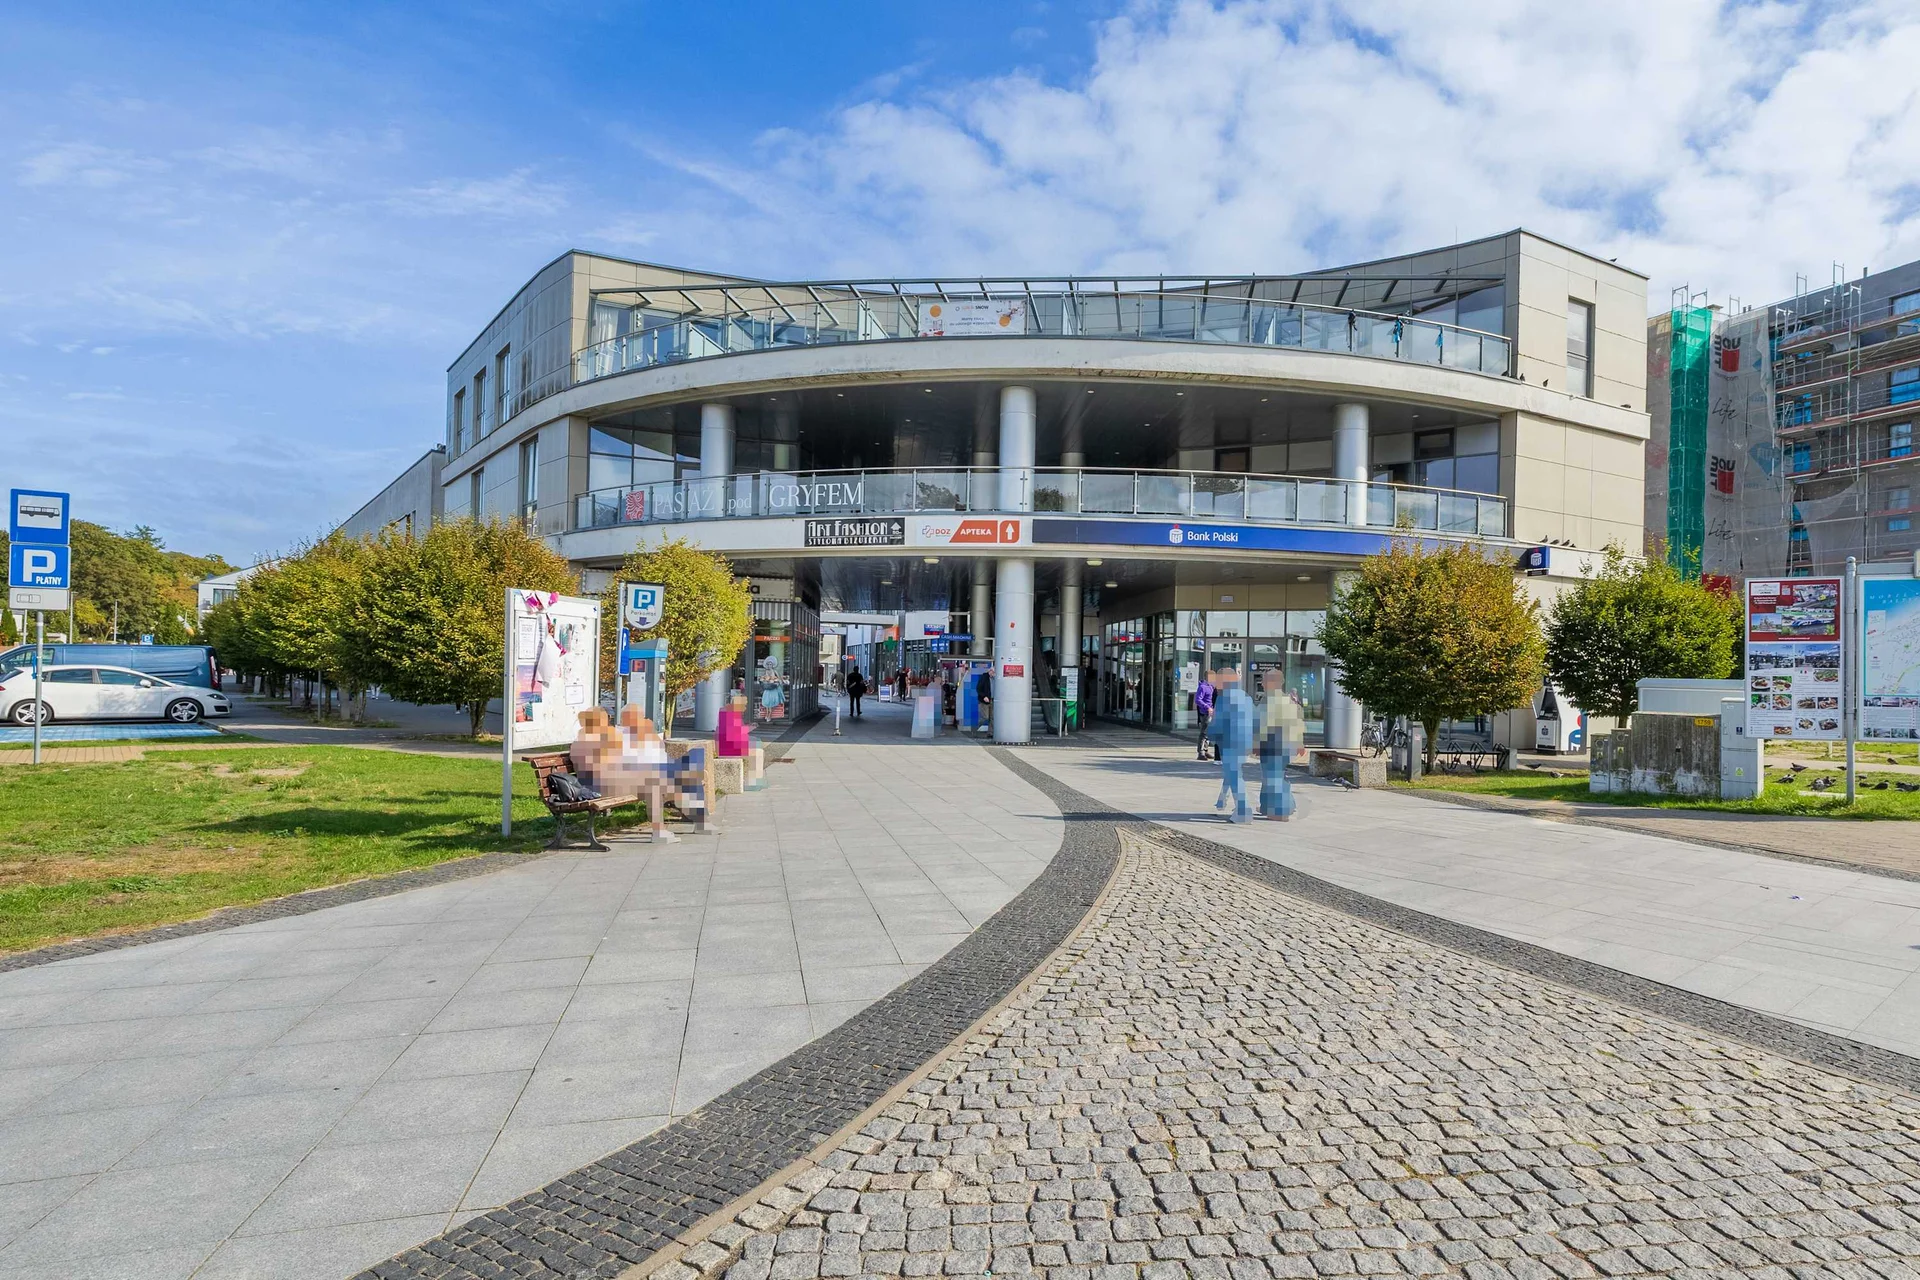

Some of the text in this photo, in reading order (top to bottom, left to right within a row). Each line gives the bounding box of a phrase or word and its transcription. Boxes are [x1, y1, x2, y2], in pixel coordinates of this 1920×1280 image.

[728, 493, 752, 513] pod
[769, 482, 862, 508] GRYFEM
[1187, 530, 1239, 543] Bank Polski
[23, 549, 56, 582] P
[35, 576, 62, 585] PŁATNY
[638, 591, 651, 607] P
